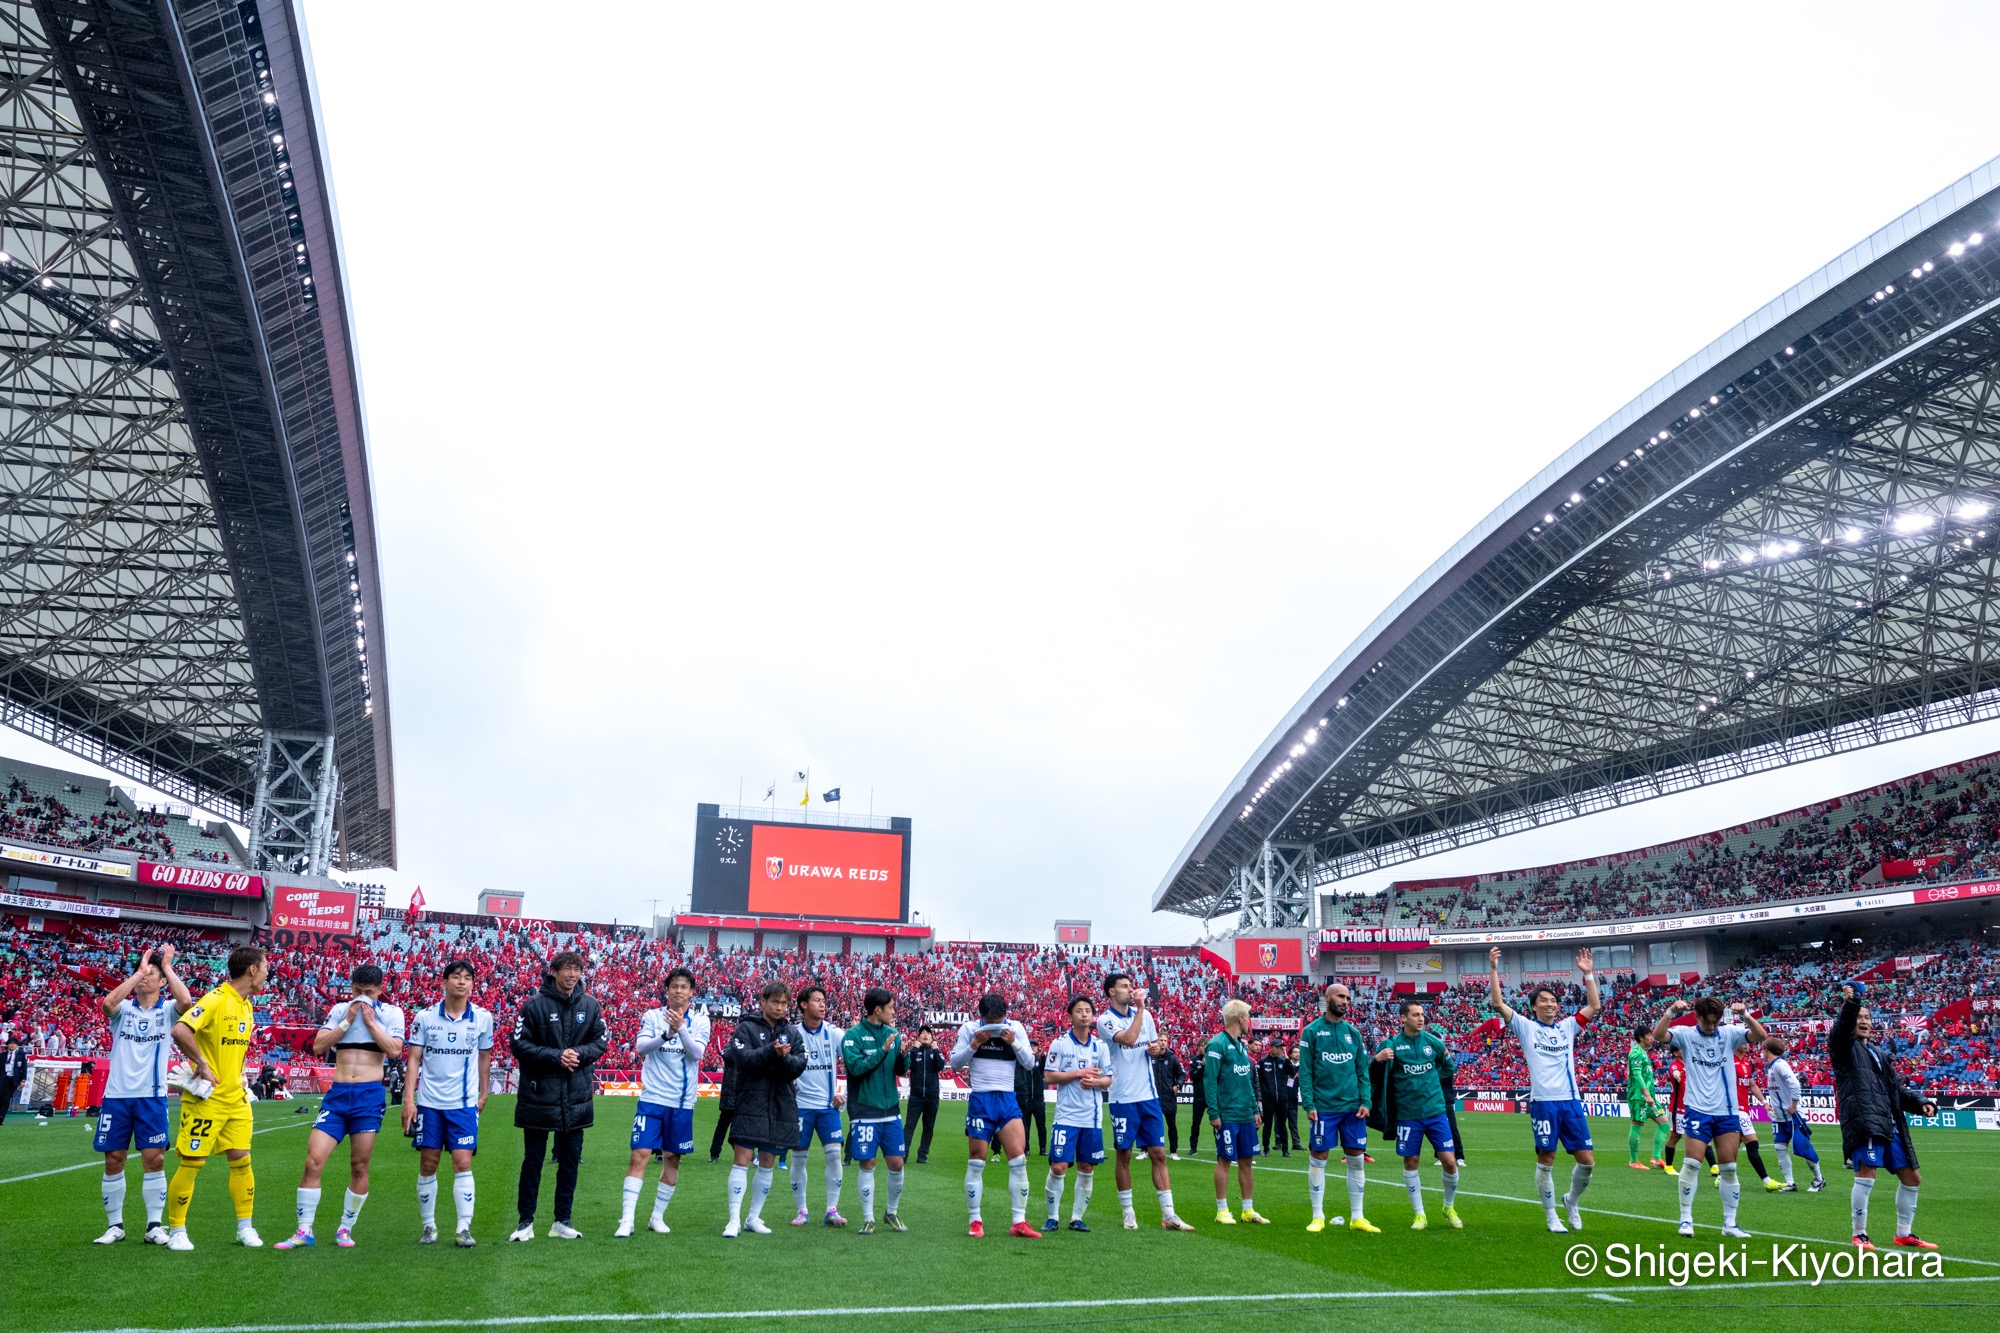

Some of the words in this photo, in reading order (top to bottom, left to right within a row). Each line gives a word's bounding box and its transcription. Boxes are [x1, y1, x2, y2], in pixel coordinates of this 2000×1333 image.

[1913, 859, 1927, 867] 505
[152, 865, 175, 882] GO
[176, 868, 225, 889] REDS
[225, 874, 250, 891] GO
[789, 864, 843, 879] URAWA
[848, 868, 889, 882] REDS
[286, 892, 320, 901] COME
[66, 903, 116, 916] 川口短期大学
[299, 900, 317, 908] ON
[307, 905, 346, 917] REDS!
[382, 911, 396, 923] LIFE
[119, 921, 142, 935] THE
[143, 925, 176, 937] HUNT
[1318, 930, 1339, 943] The
[1340, 930, 1372, 943] Pride
[1374, 930, 1387, 943] of
[1388, 928, 1430, 942] URAWA
[1553, 930, 1585, 938] Construction
[119, 1031, 165, 1043] Panasonic
[1322, 1051, 1353, 1064] ROHTO
[1403, 1062, 1433, 1075] ROHTO
[1476, 1091, 1491, 1101] JUST
[1491, 1091, 1500, 1101] DO
[1500, 1092, 1509, 1101] IT.
[1583, 1093, 1598, 1104] JUST
[1598, 1093, 1608, 1104] DO
[1608, 1093, 1620, 1104] IT.
[1812, 1096, 1824, 1107] DO
[1473, 1101, 1505, 1112] KONAMI
[190, 1119, 212, 1137] 22
[857, 1125, 874, 1143] 38
[1397, 1126, 1411, 1142] 47
[1537, 1120, 1551, 1136] 20
[1054, 1129, 1067, 1146] 16
[1222, 1130, 1232, 1145] 8
